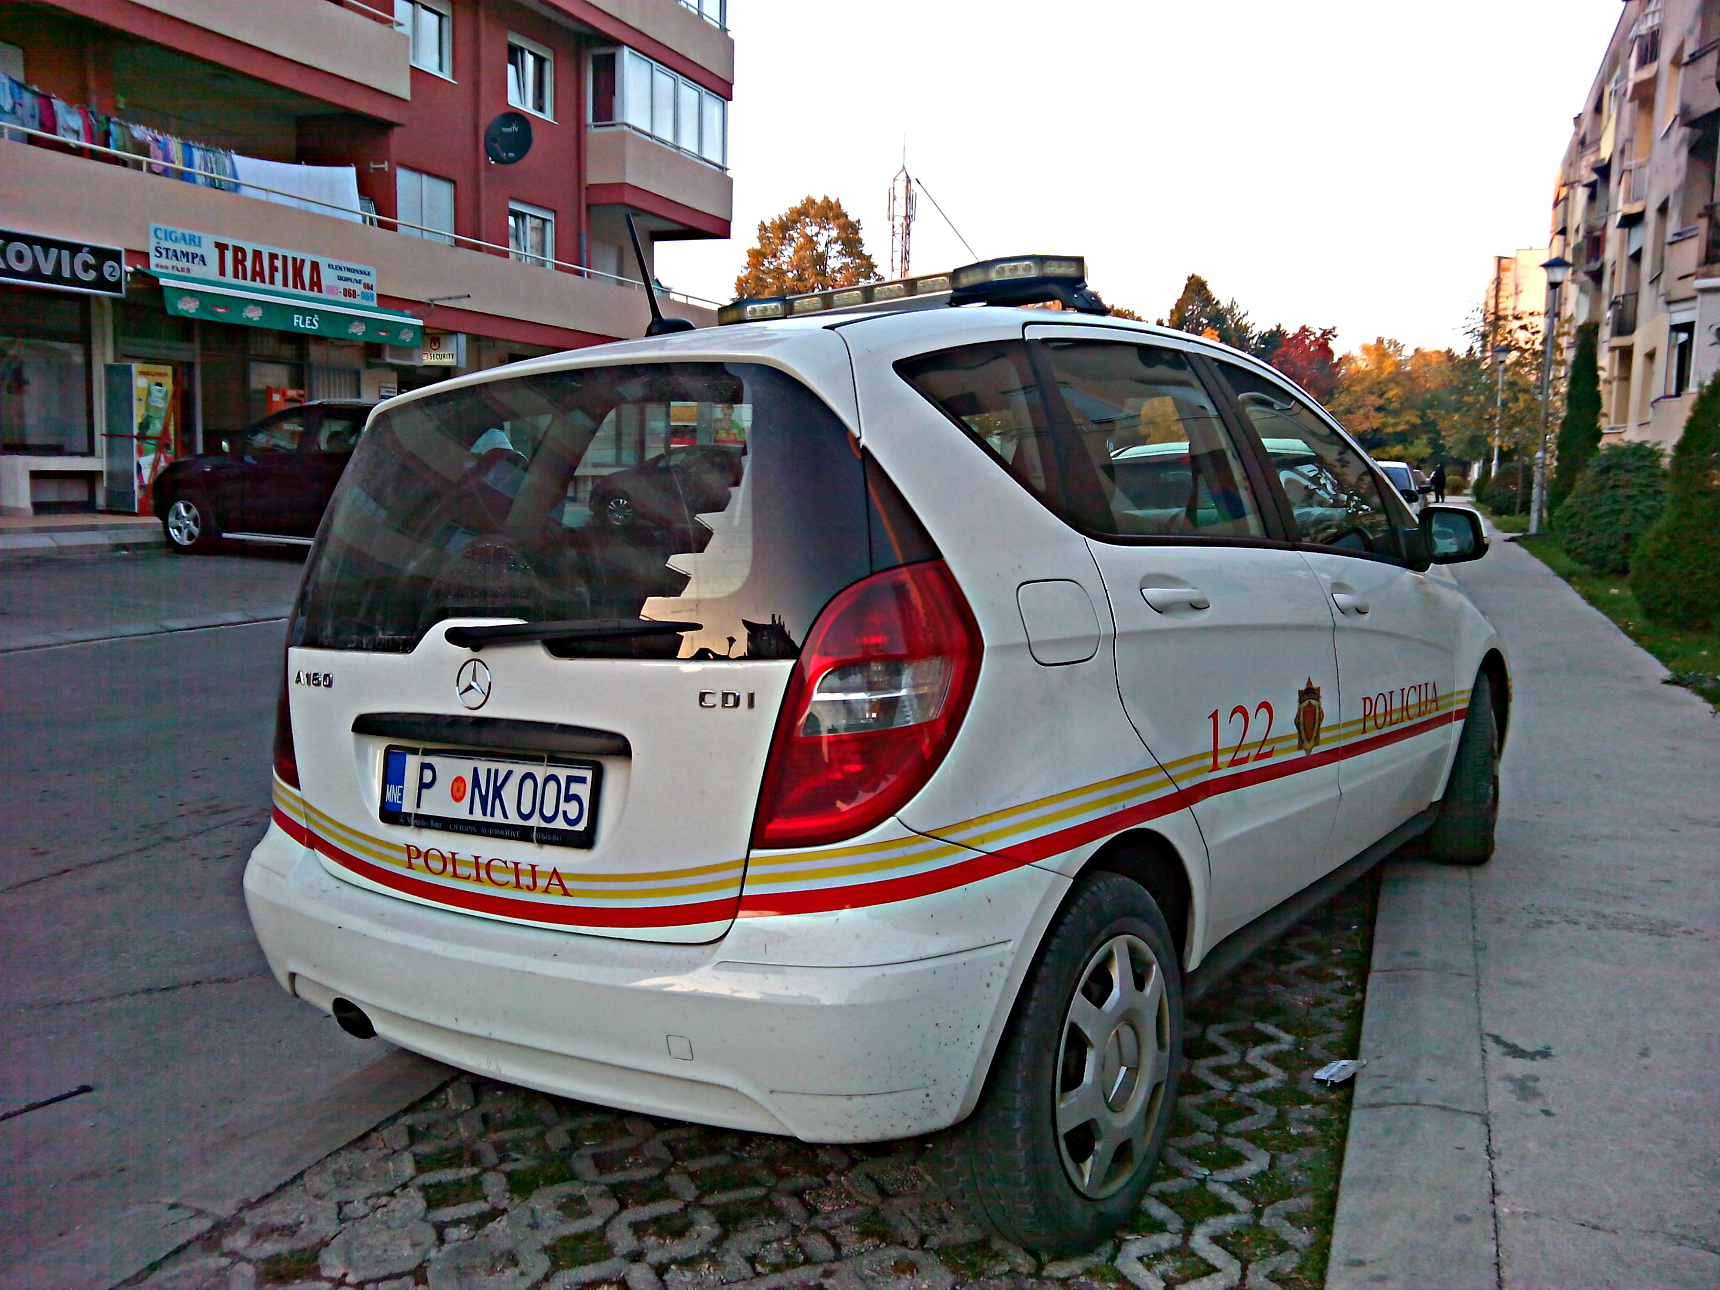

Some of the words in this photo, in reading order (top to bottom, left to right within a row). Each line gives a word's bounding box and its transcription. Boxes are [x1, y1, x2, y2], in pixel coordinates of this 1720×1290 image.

[153, 227, 202, 248] CIGARI
[154, 241, 208, 267] ŠTAMPA
[0, 239, 96, 281] OVIĆ
[213, 240, 323, 294] TRAFIKA
[293, 314, 319, 330] FLEŠ
[429, 352, 455, 361] SECURITY
[698, 688, 755, 710] CDI
[1361, 681, 1440, 735] POLICIJA
[1207, 700, 1275, 773] 122
[385, 783, 404, 804] MNE
[416, 762, 437, 809] P
[404, 843, 574, 898] POLICIJA
